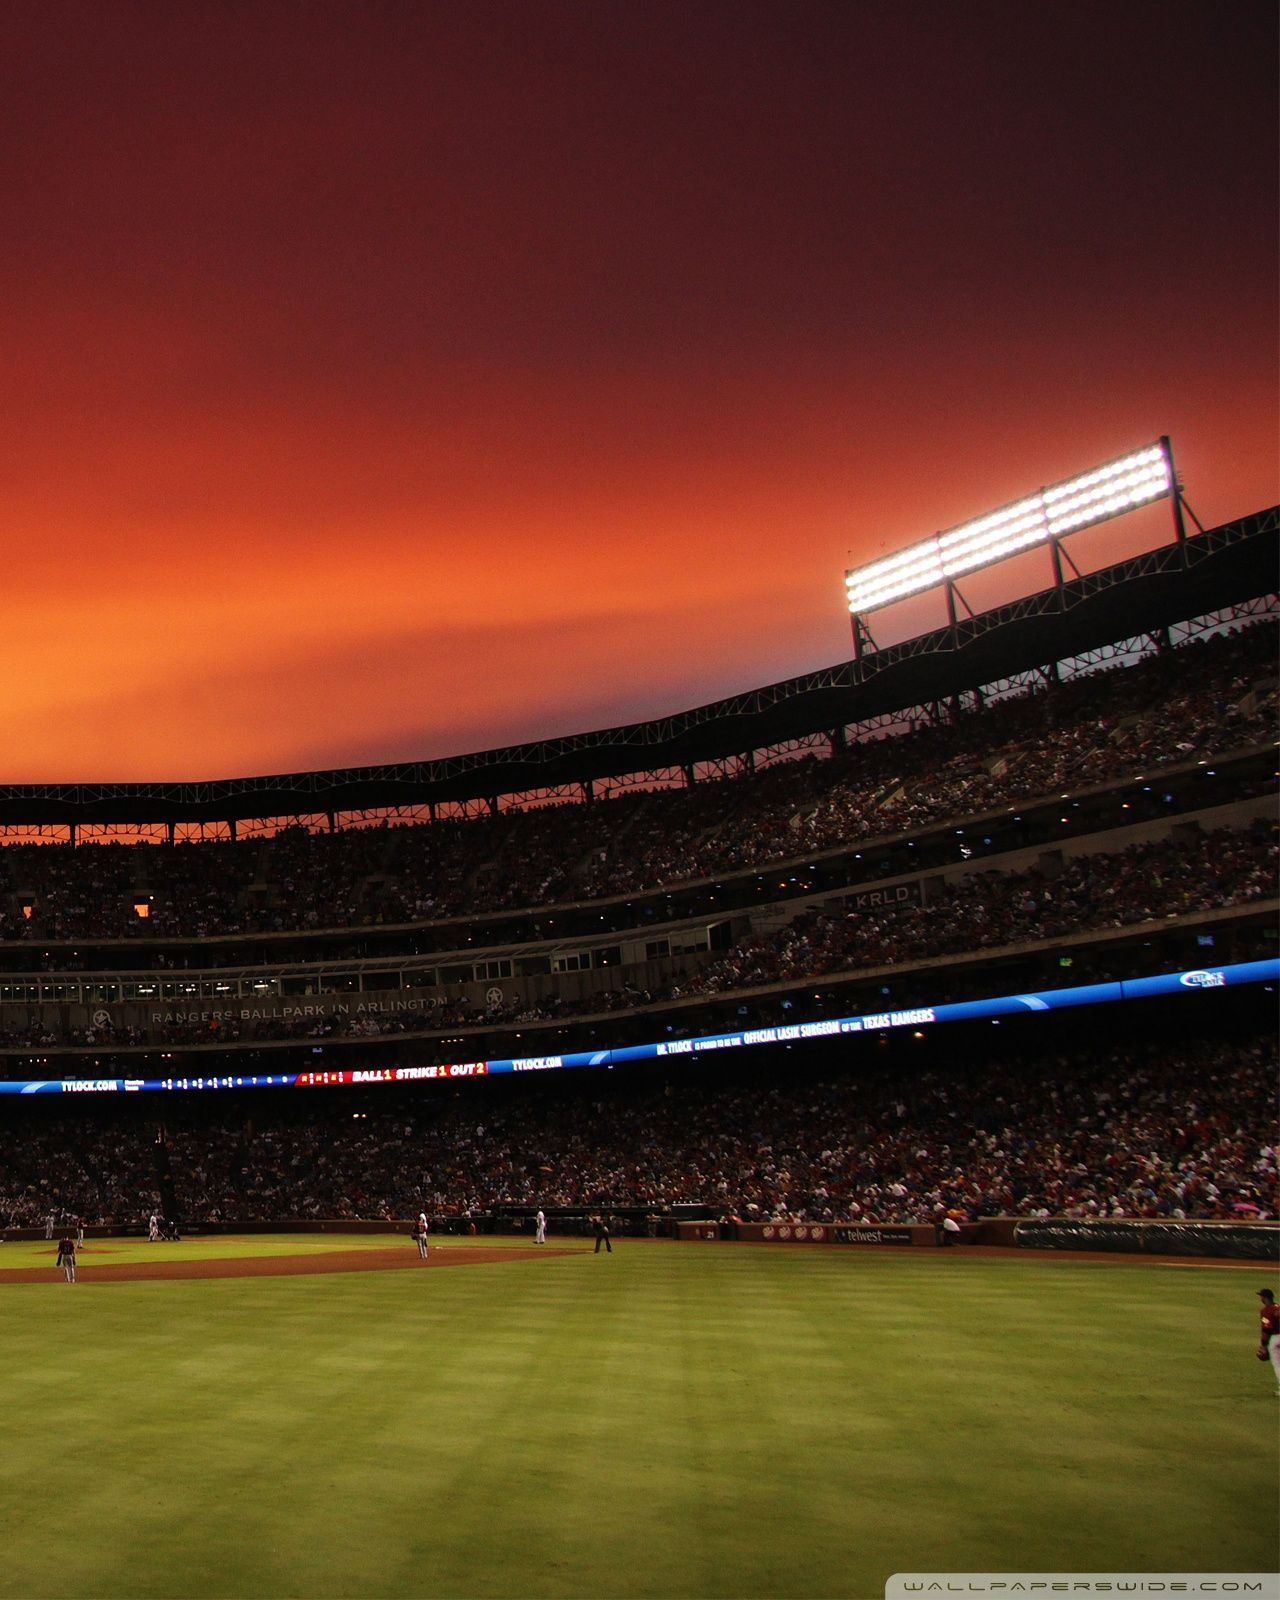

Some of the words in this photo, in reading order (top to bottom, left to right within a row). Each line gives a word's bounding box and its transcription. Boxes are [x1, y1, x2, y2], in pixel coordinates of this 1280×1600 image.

[856, 887, 909, 909] KRLD
[152, 1011, 234, 1023] RANGERS
[240, 1005, 326, 1020] BALLPARK
[332, 1004, 349, 1013] IN
[356, 996, 449, 1013] ARLINGTON
[743, 1030, 777, 1045] OFFICIAL
[777, 1026, 801, 1041] LASIK
[800, 1021, 840, 1037] SURGEON
[862, 1014, 891, 1029] TEXAS
[890, 1008, 936, 1026] RANGERS
[352, 1071, 383, 1083] BALL
[383, 1069, 393, 1080] 1
[395, 1066, 437, 1080] STRIKE
[437, 1064, 448, 1077] 1
[449, 1063, 477, 1076] OUT
[476, 1062, 486, 1075] 2
[512, 1056, 562, 1071] TYLOCK.COM
[61, 1081, 118, 1092] TYLOCK.COM
[847, 1228, 882, 1242] telwest
